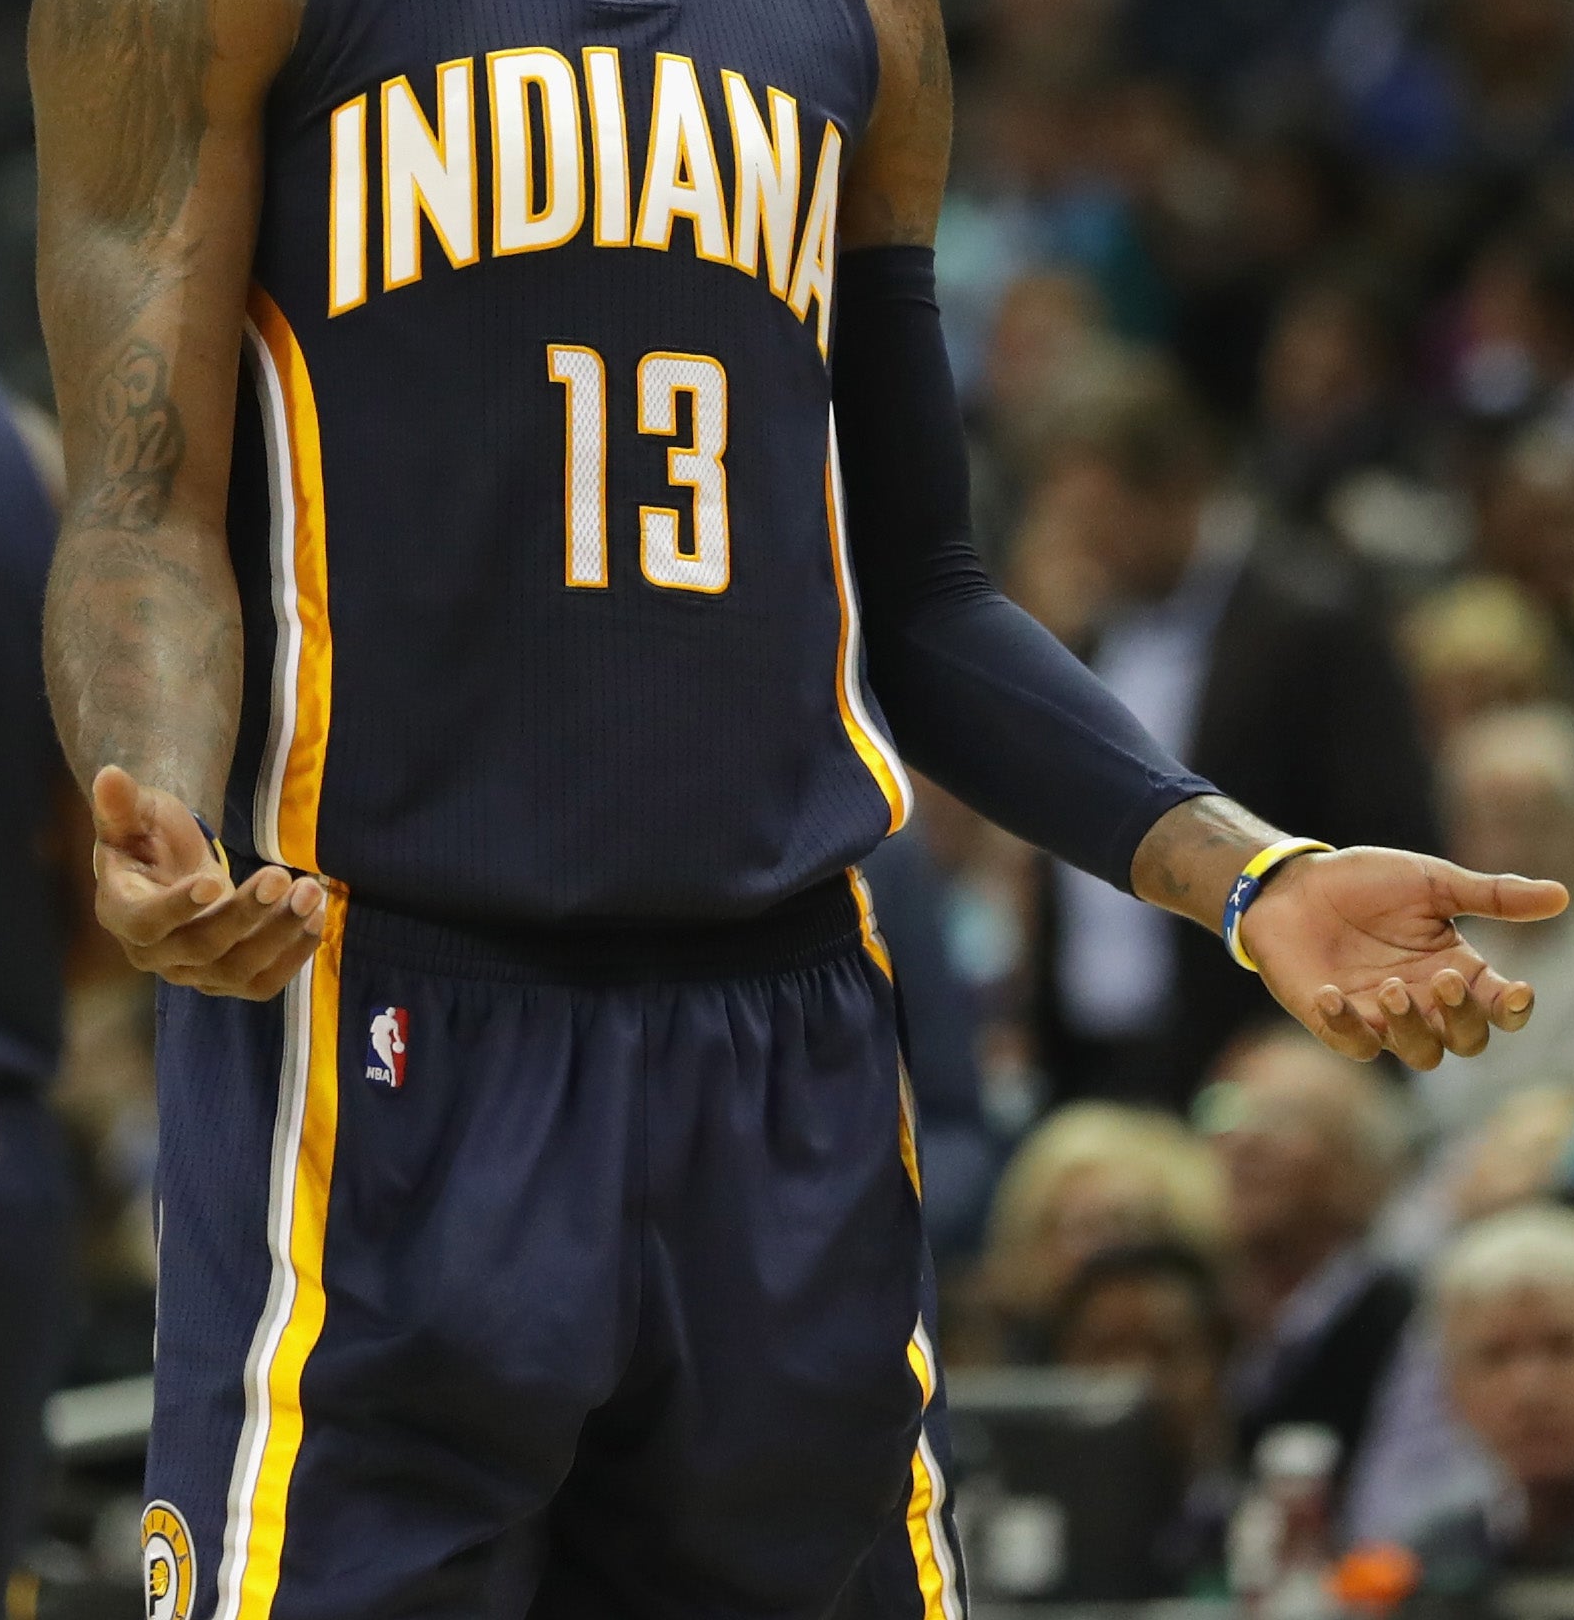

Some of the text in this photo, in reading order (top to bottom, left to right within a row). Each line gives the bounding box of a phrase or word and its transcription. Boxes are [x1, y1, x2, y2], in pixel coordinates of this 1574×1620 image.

[328, 46, 842, 365] INDIANA
[547, 343, 730, 594] 13
[366, 1066, 391, 1083] NBA
